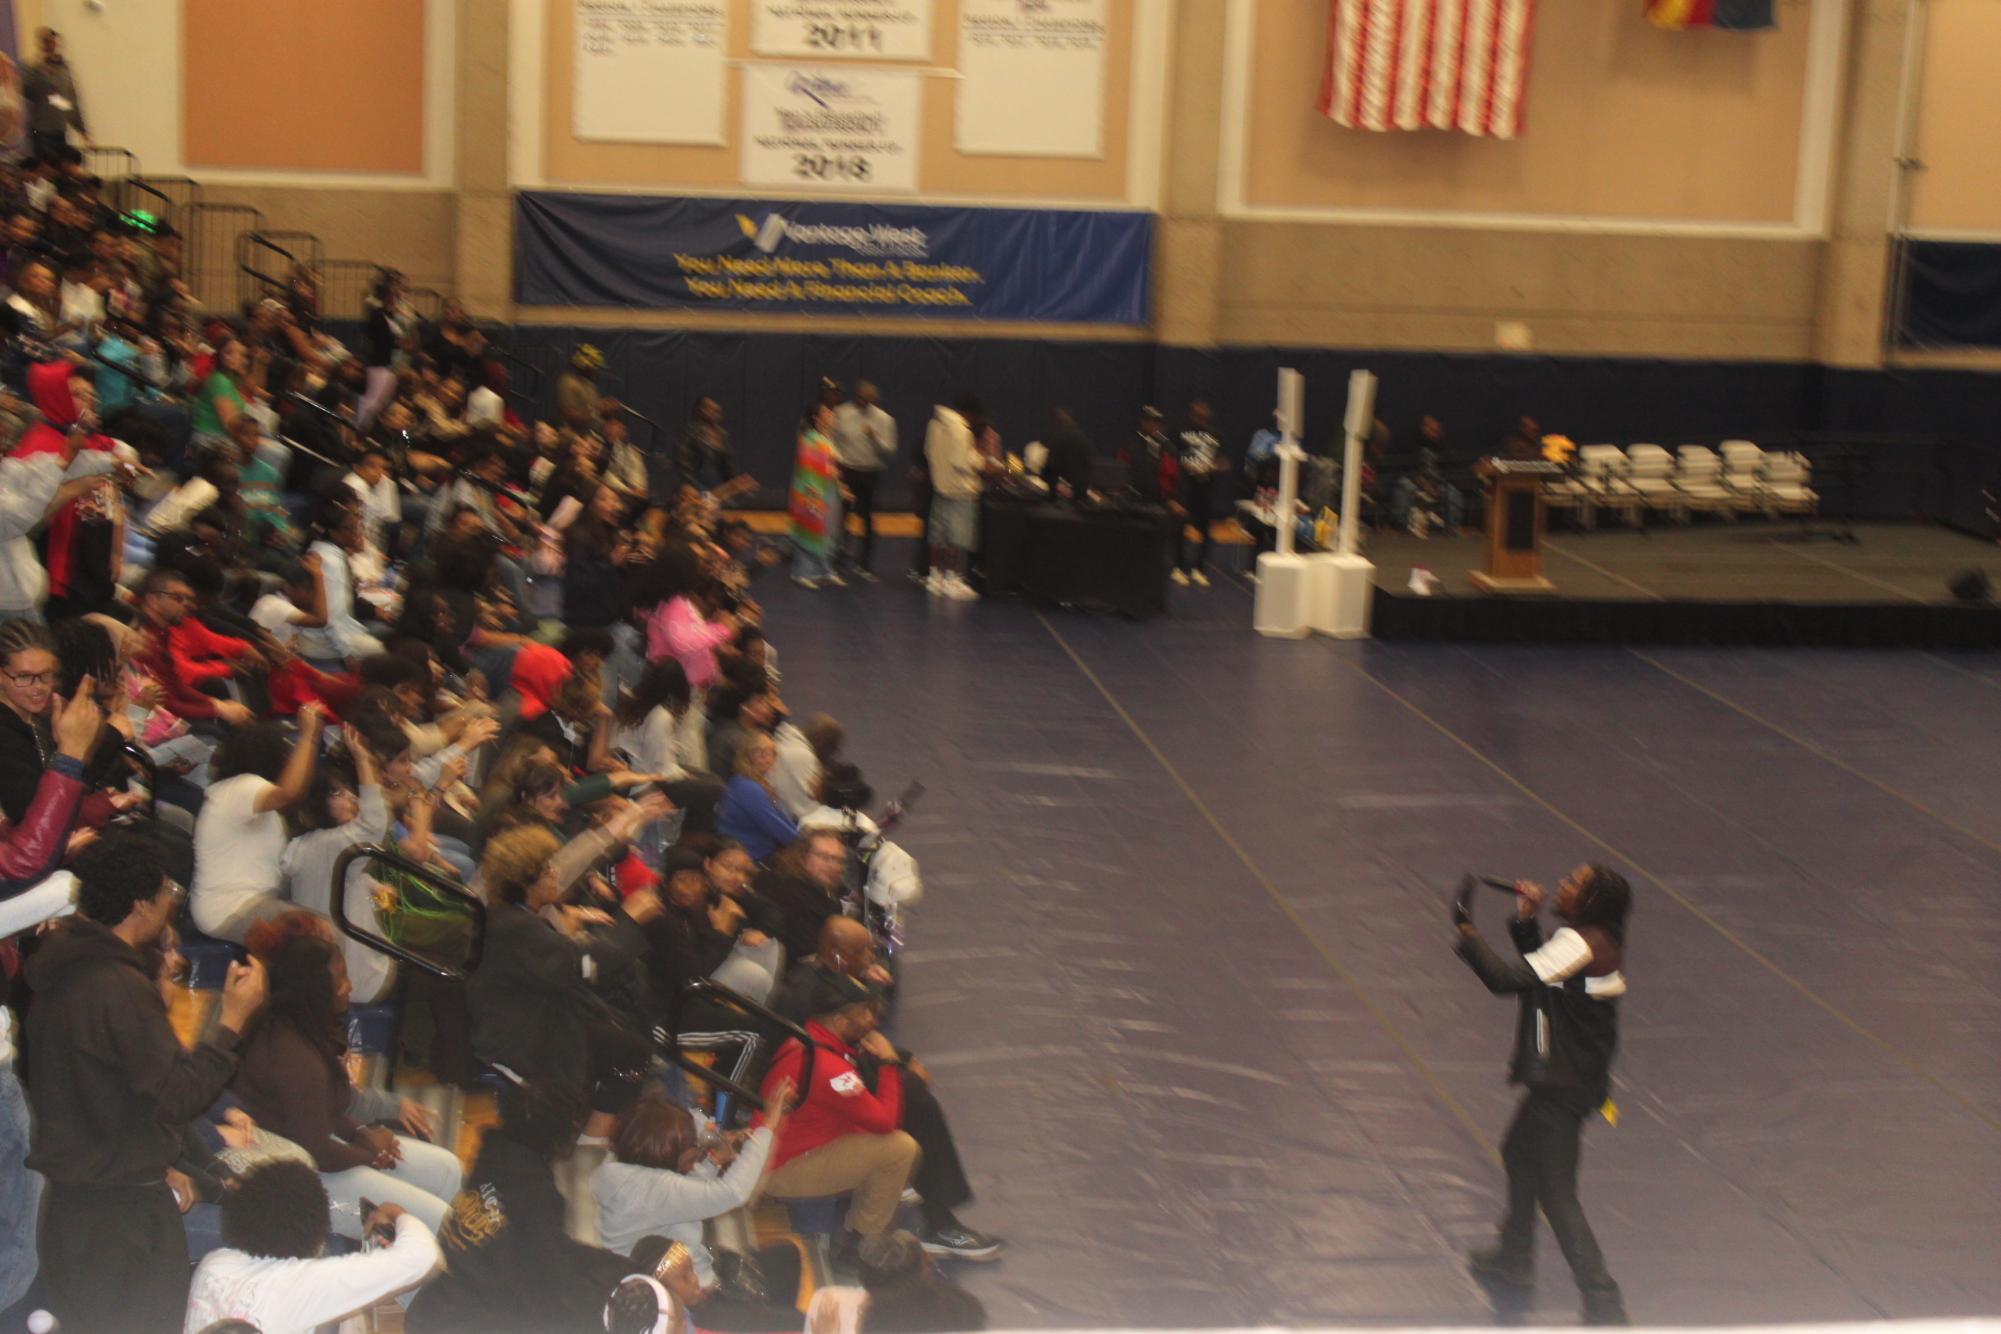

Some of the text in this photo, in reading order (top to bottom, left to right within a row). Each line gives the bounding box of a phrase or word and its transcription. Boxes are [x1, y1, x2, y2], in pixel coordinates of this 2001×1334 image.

[803, 23, 882, 50] 2011
[792, 154, 872, 181] 2018
[674, 252, 719, 274] You
[718, 255, 775, 277] Need
[774, 256, 830, 278] More
[684, 277, 729, 298] You
[728, 278, 785, 300] Need
[804, 279, 899, 304] Financial
